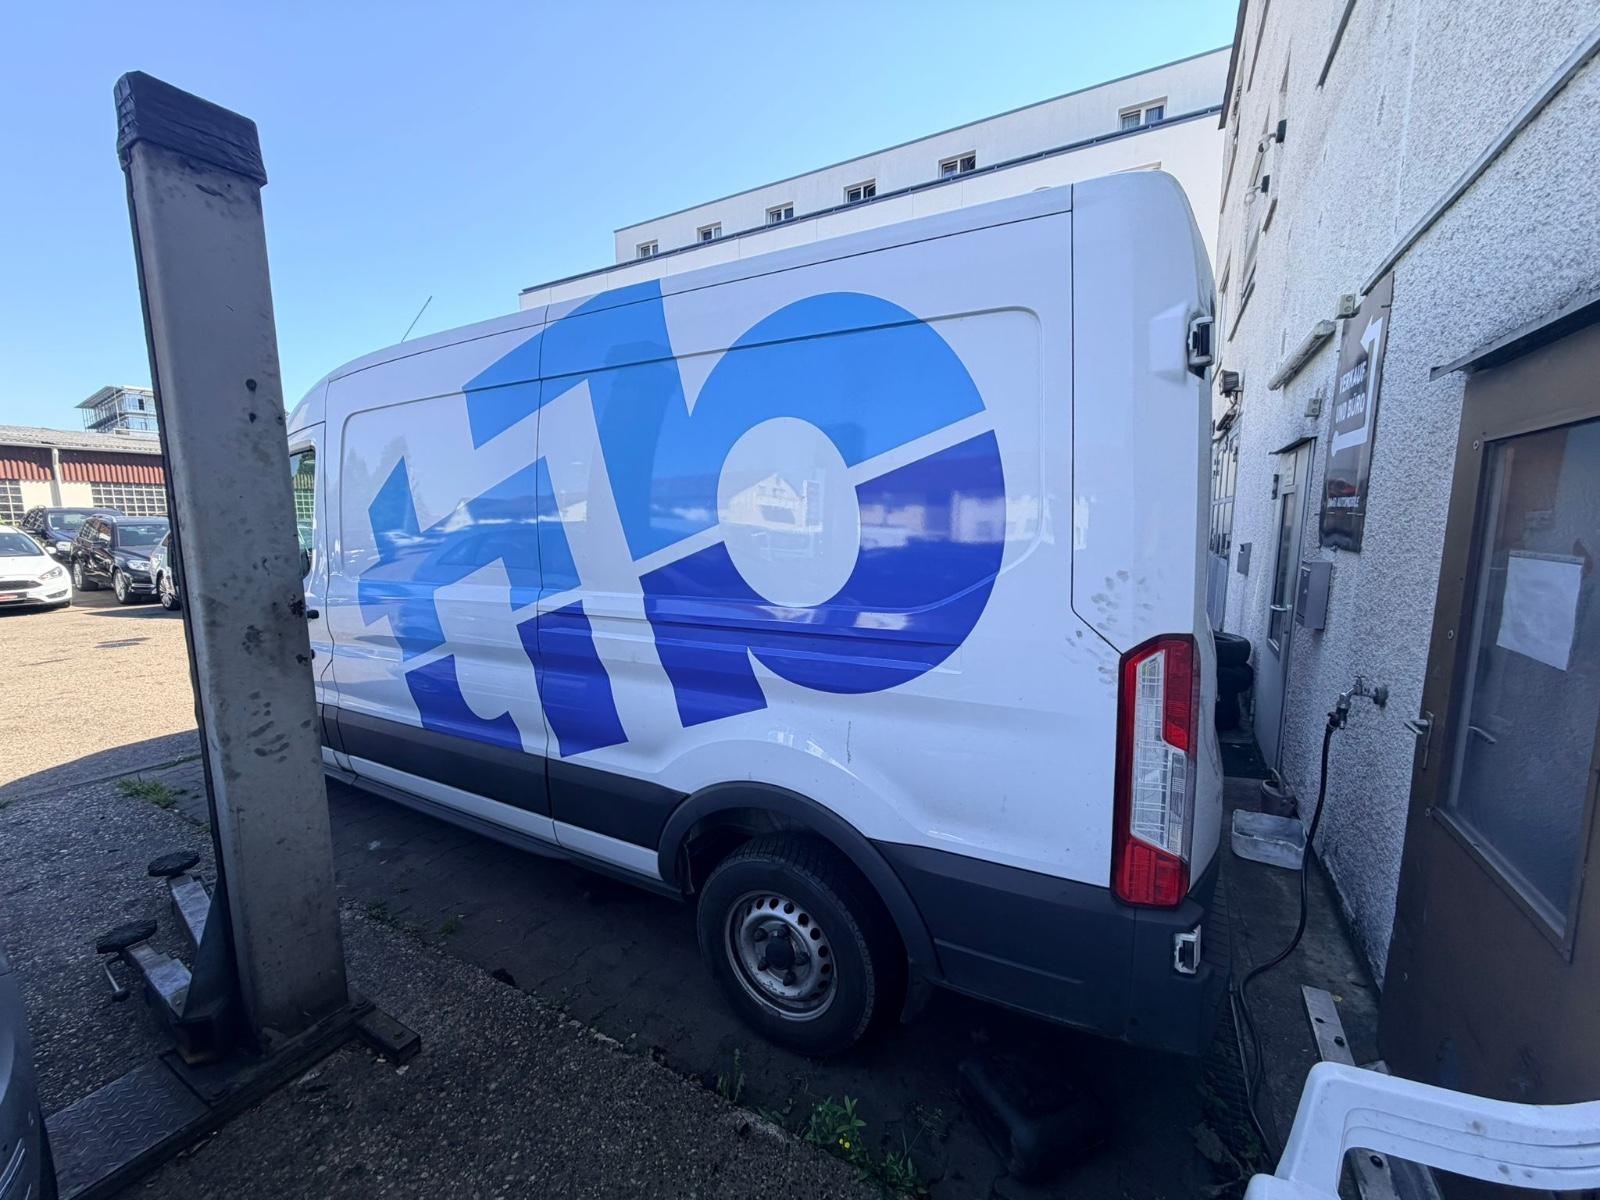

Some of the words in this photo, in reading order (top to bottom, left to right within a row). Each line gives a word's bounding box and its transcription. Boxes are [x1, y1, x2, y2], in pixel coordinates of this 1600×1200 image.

[1339, 360, 1367, 394] VERKAUF
[1335, 401, 1347, 424] UND
[1347, 392, 1366, 418] BÜRO
